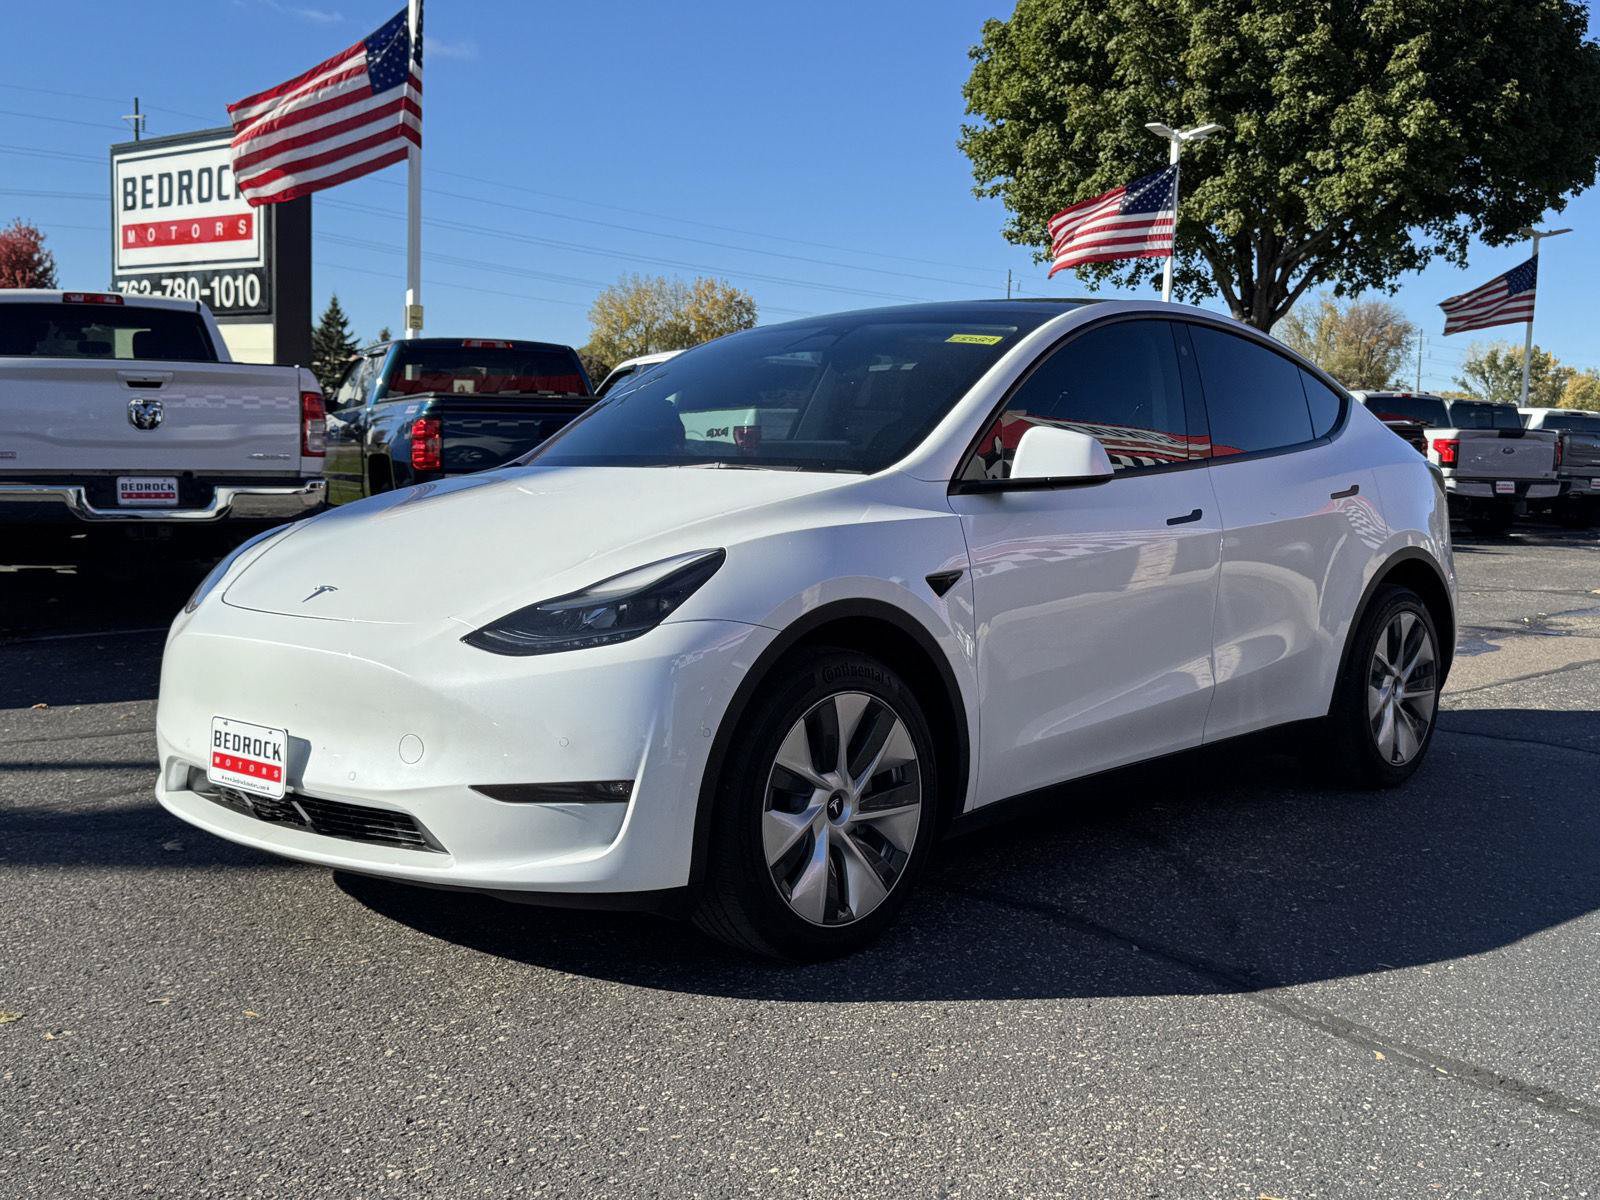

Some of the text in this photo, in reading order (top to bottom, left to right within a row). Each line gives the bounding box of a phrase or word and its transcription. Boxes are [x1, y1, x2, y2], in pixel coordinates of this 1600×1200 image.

[123, 164, 241, 211] BEDROC
[127, 219, 247, 243] MOTORS
[121, 482, 175, 491] BEDROCK
[822, 662, 885, 683] Continental
[213, 729, 282, 762] BEDROCK
[214, 756, 280, 779] MOTORS
